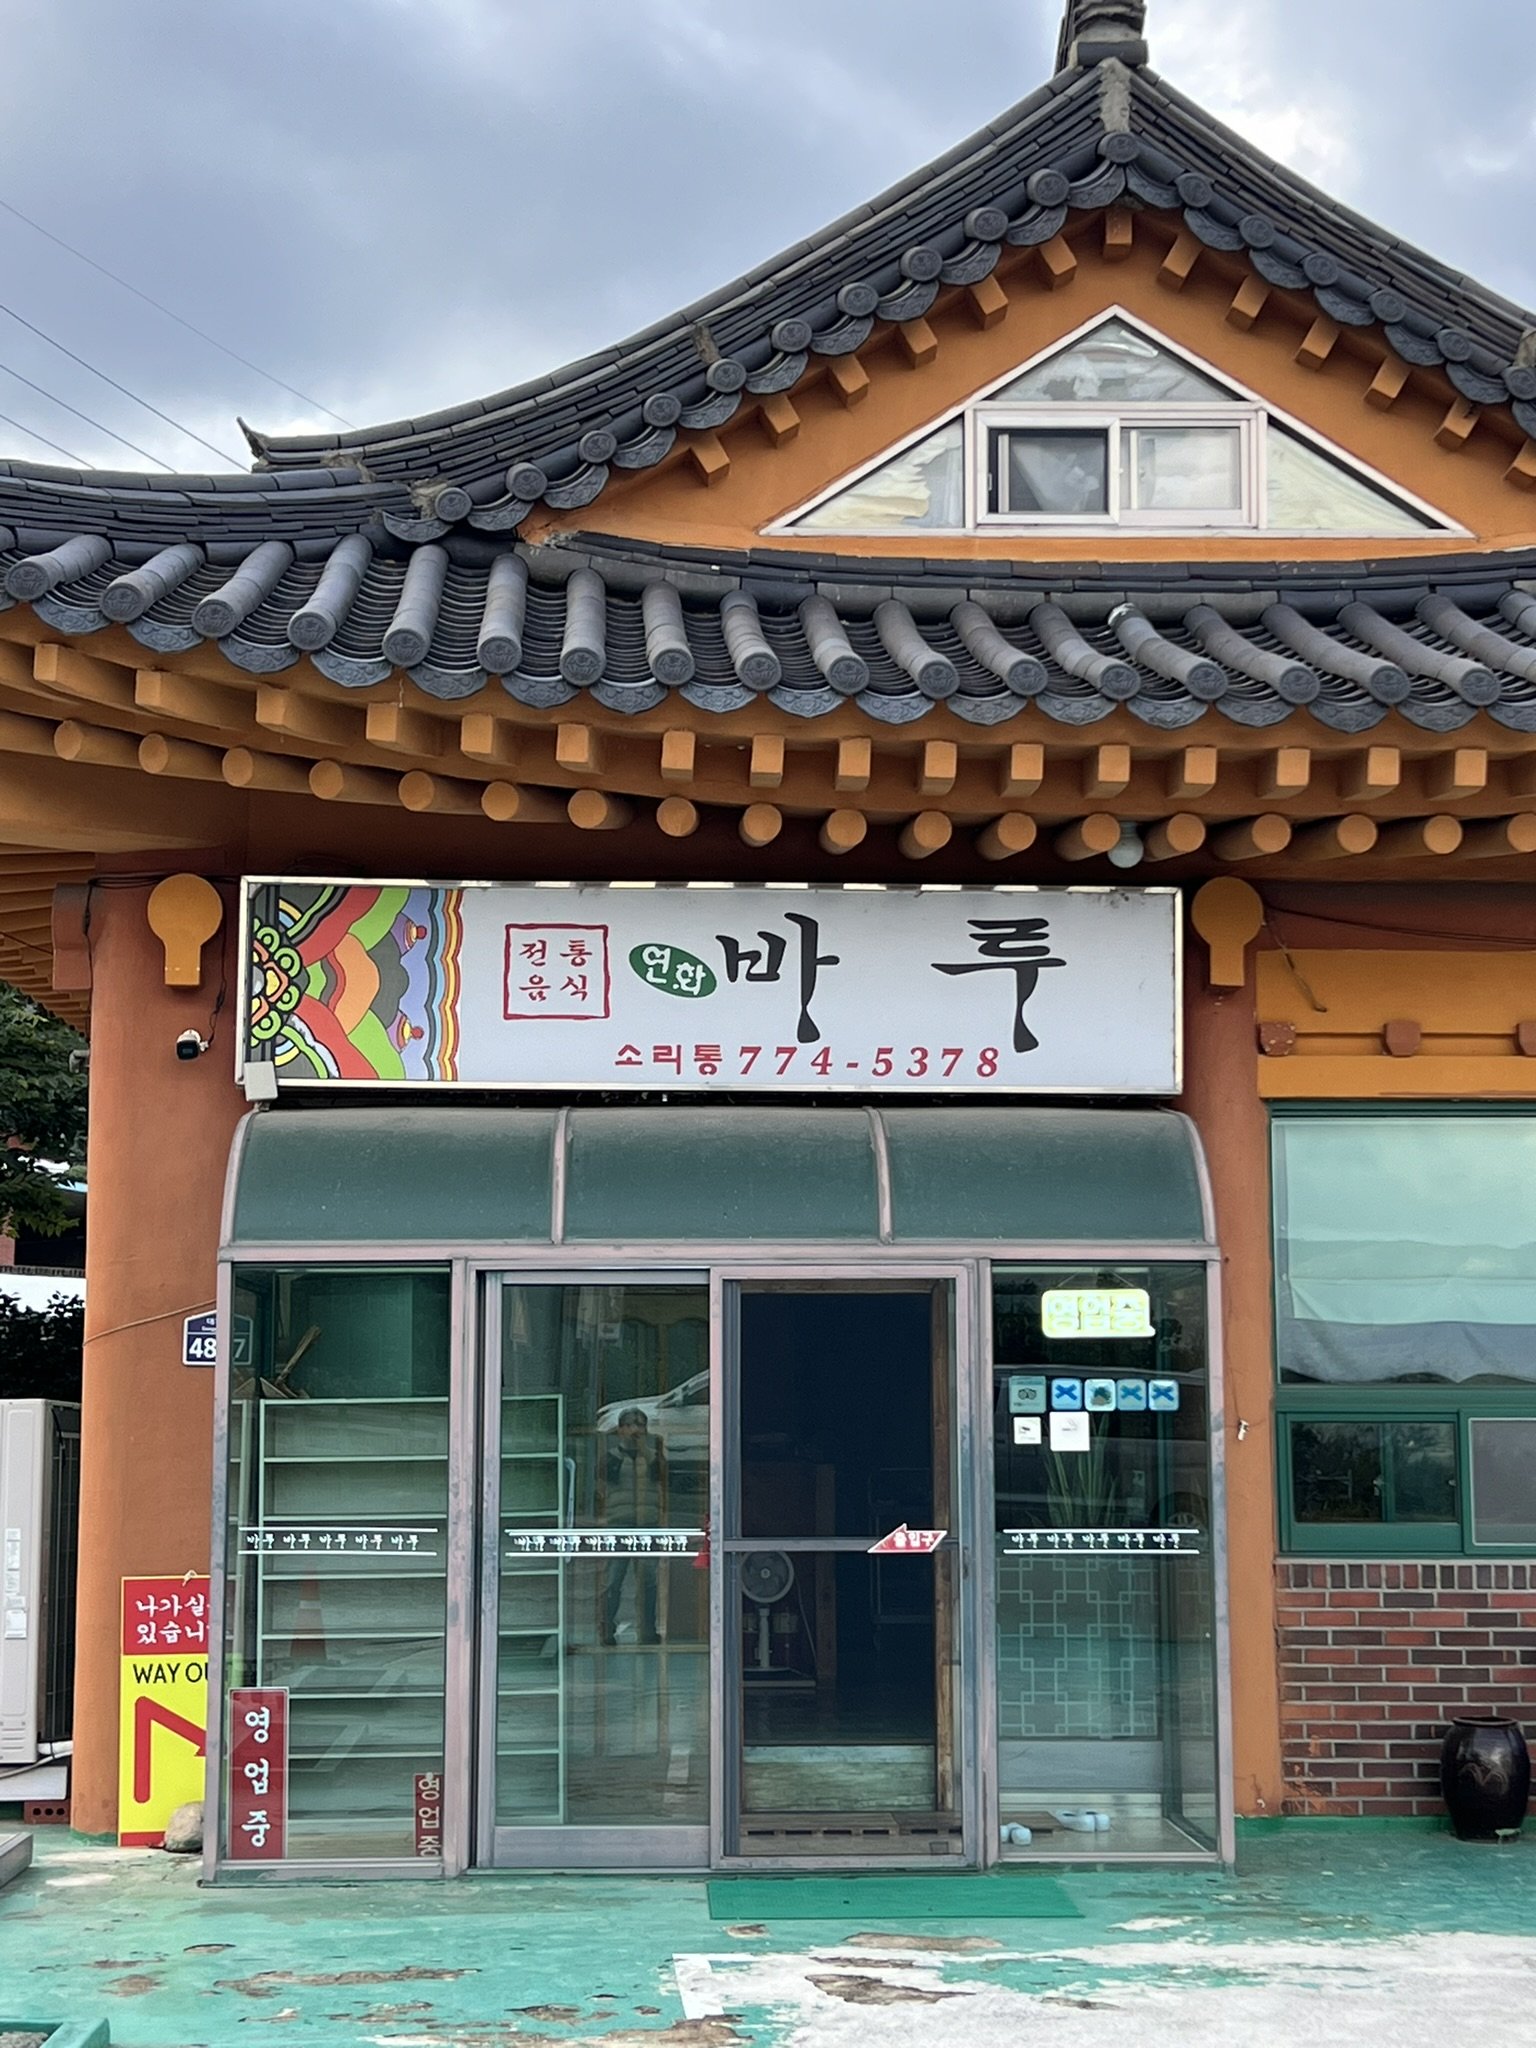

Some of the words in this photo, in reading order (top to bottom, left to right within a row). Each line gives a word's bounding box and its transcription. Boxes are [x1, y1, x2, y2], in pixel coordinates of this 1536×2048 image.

[519, 939, 592, 967] 전통
[519, 975, 588, 1001] 음식
[615, 1044, 722, 1075] 소리통
[739, 1046, 999, 1077] 774-5378
[137, 1620, 210, 1645] 있습니
[132, 1663, 181, 1684] WAY
[241, 1706, 271, 1848] 영업중
